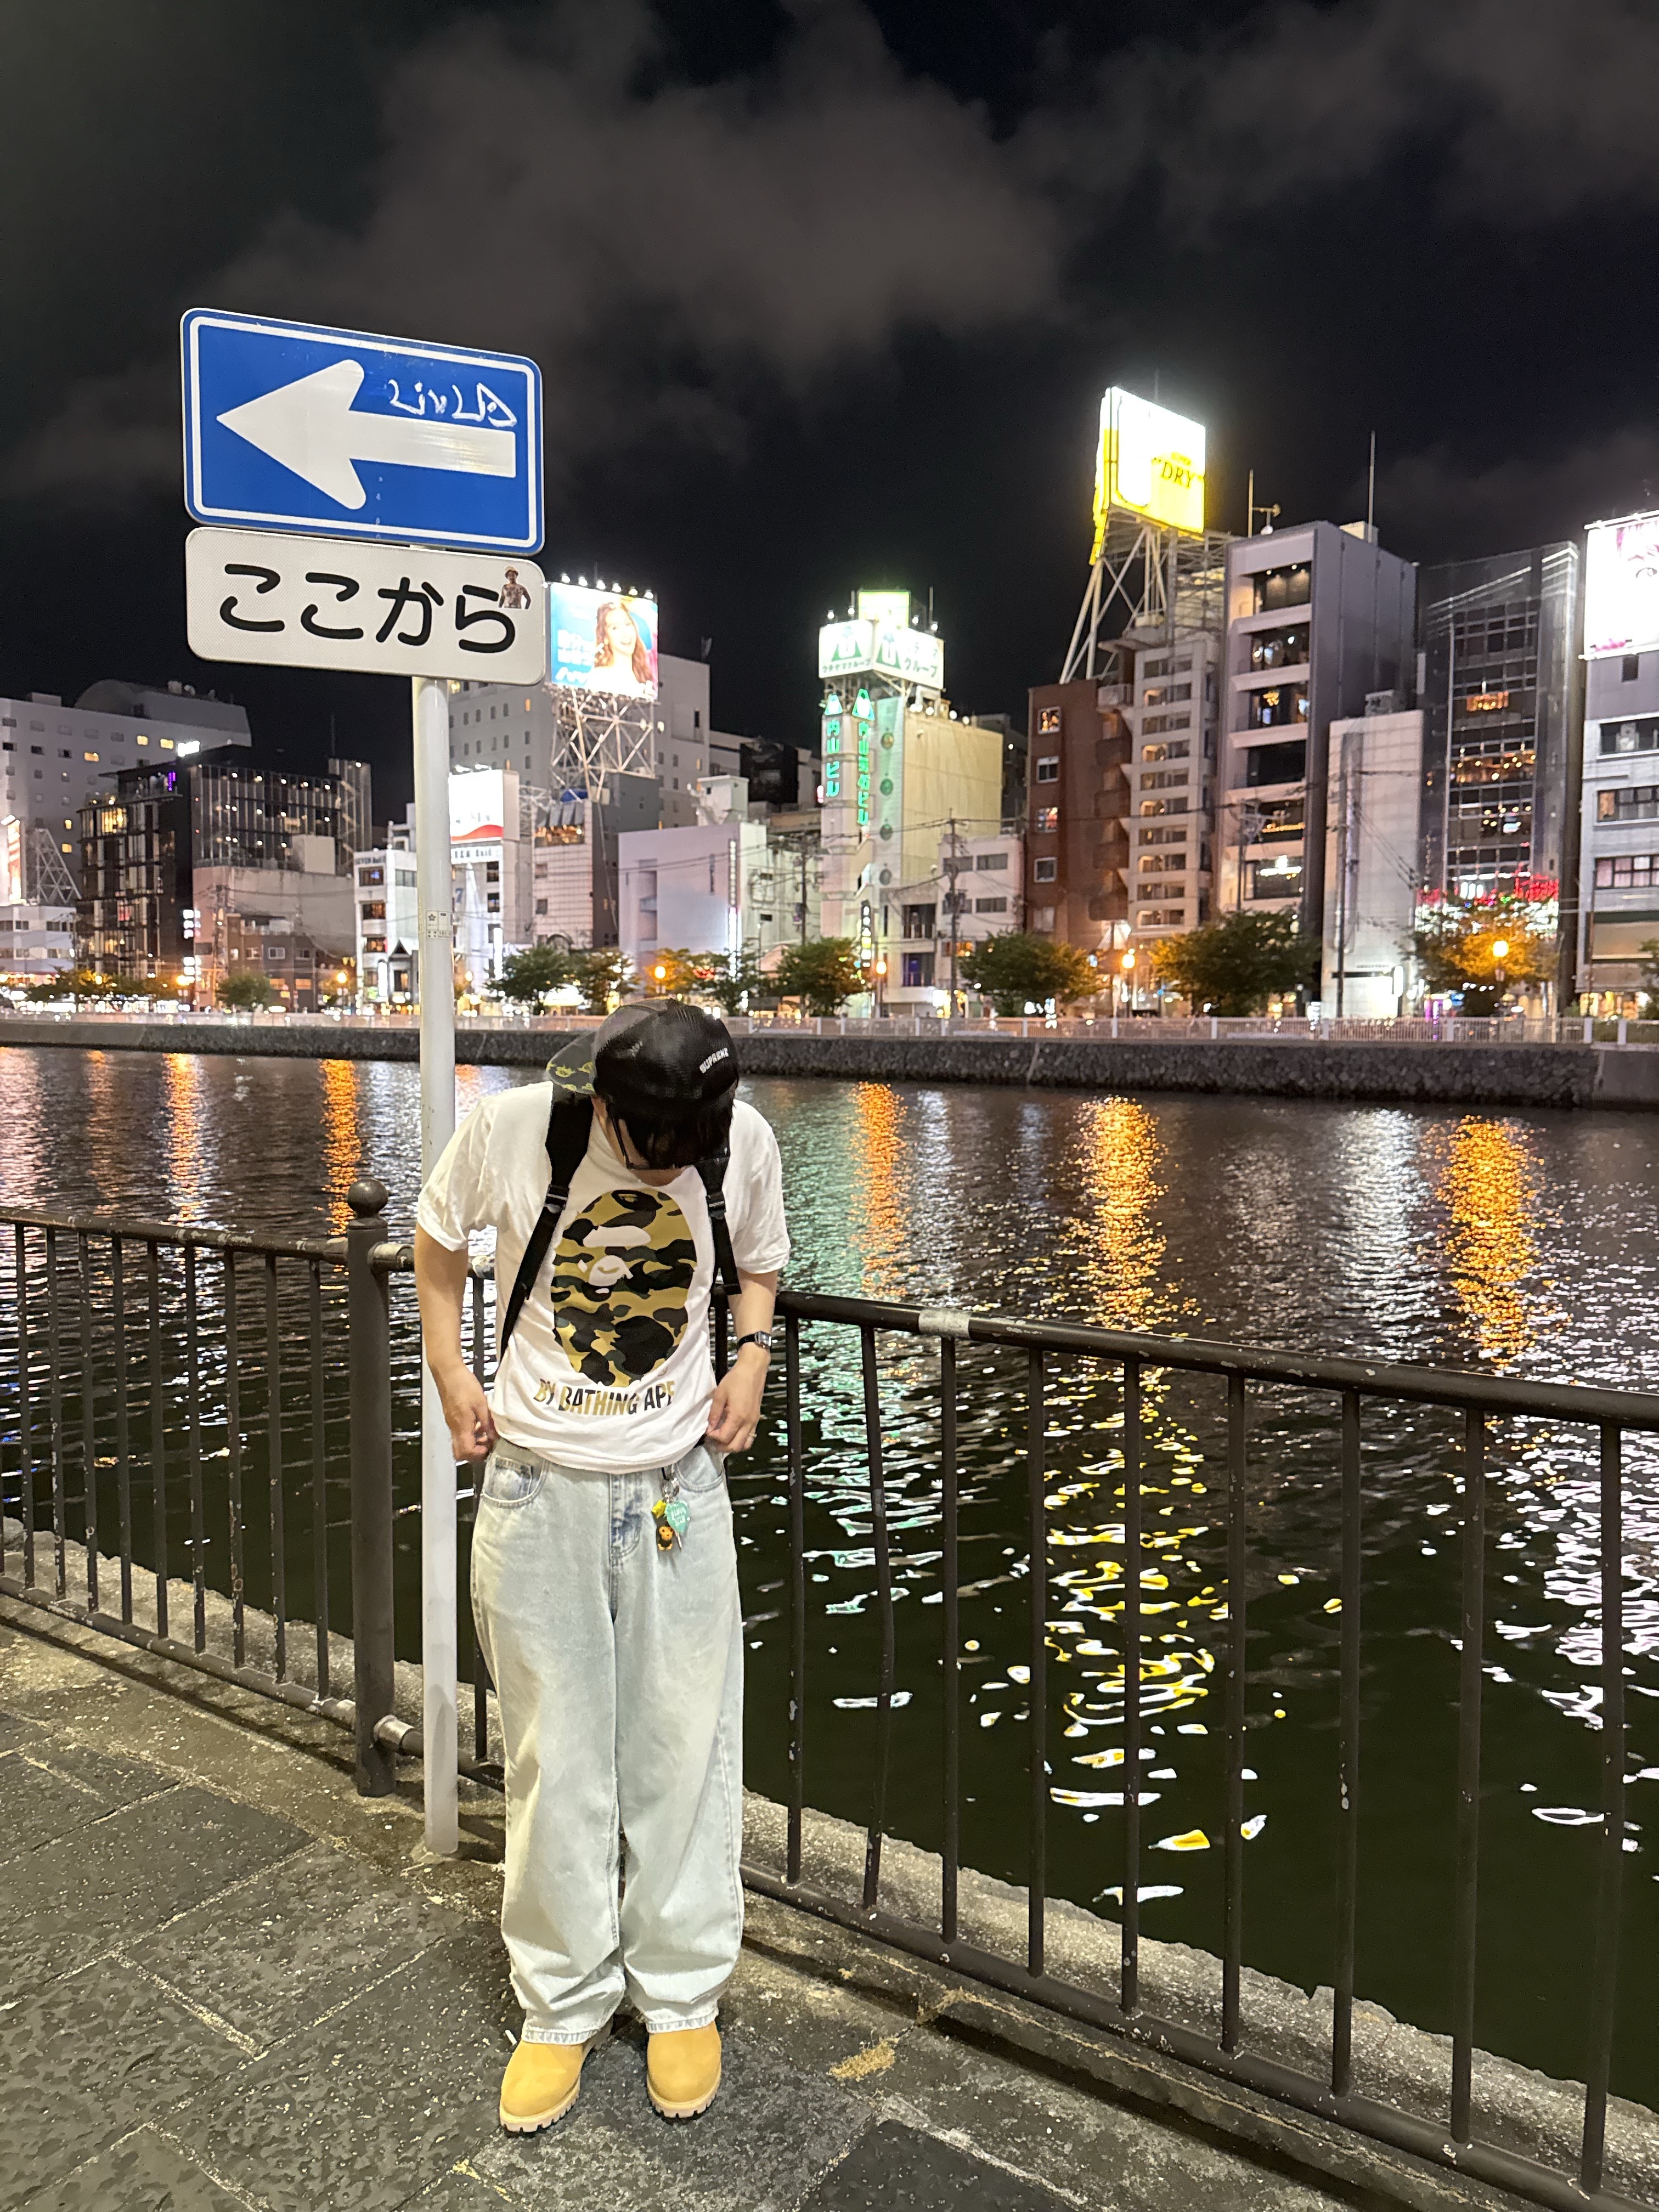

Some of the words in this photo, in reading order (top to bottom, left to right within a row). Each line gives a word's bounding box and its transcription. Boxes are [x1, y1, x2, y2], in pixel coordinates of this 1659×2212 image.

[219, 563, 516, 653] ここから
[699, 1047, 729, 1074] SUPREME
[558, 1386, 640, 1415] BATHING
